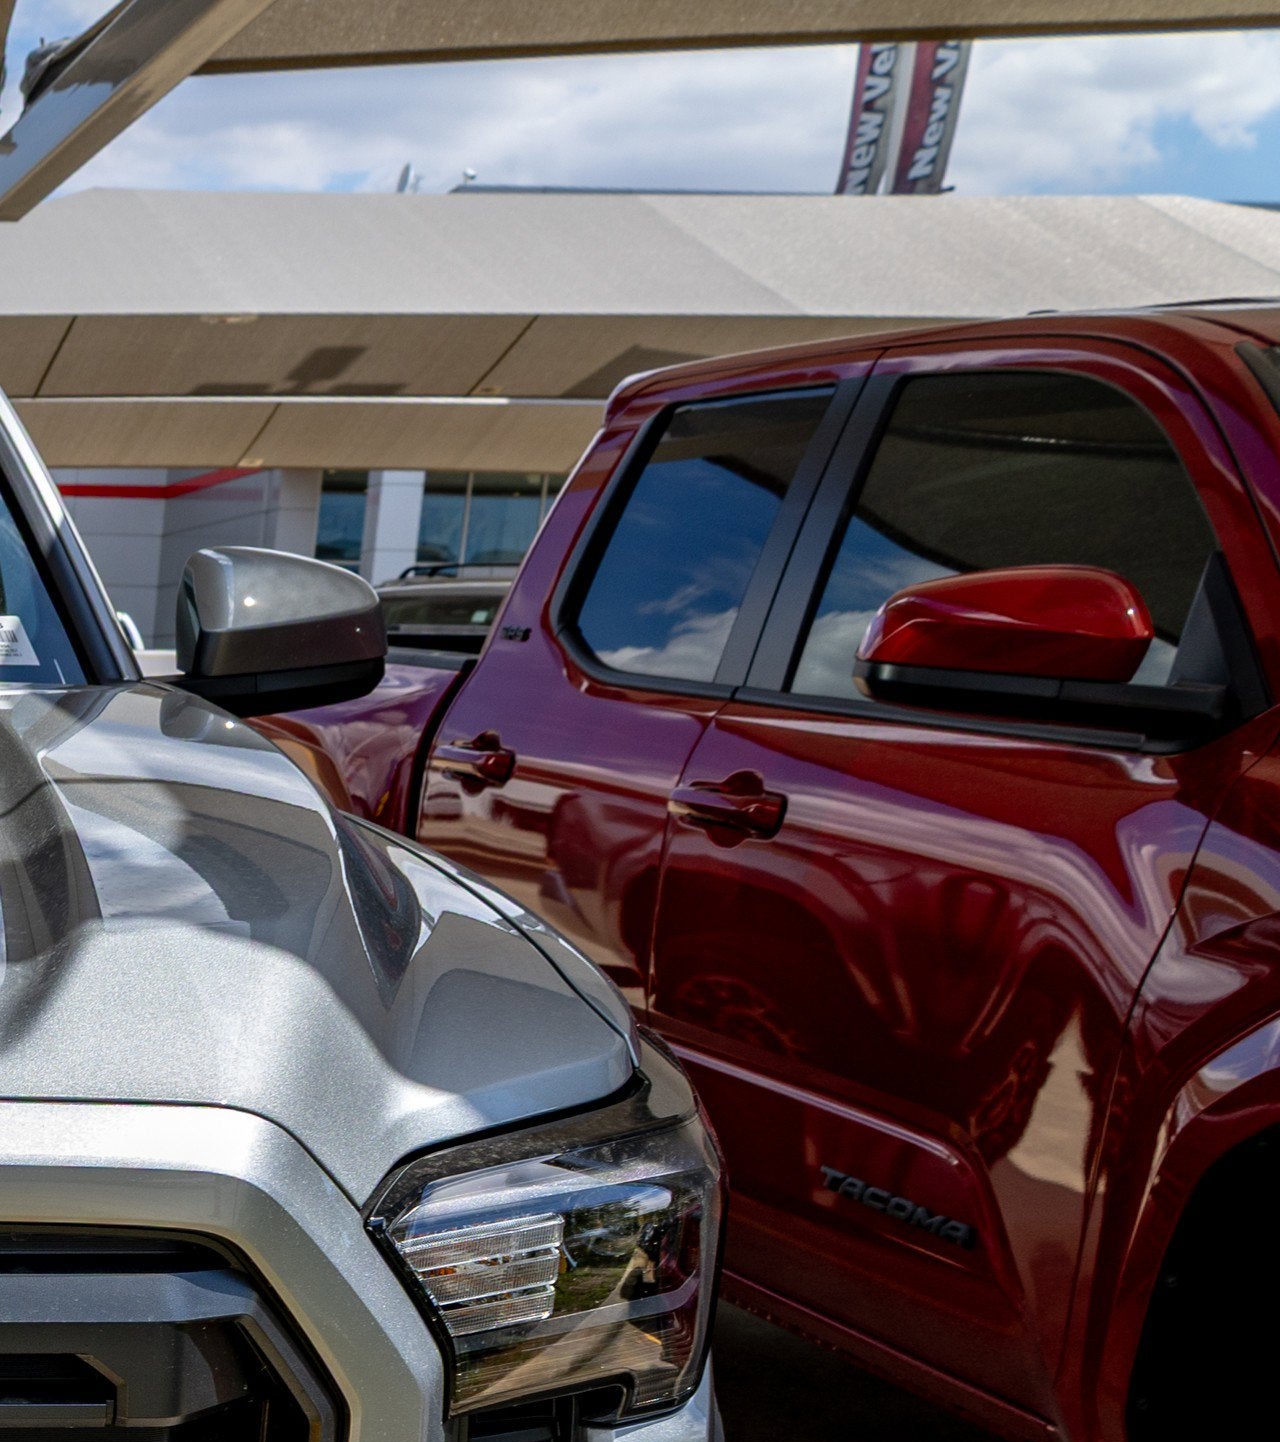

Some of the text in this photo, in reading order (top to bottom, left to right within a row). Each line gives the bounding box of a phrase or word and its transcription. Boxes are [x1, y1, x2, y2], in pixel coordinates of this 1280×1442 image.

[843, 111, 885, 195] New
[907, 85, 953, 181] New
[819, 1164, 974, 1246] TACOMA
